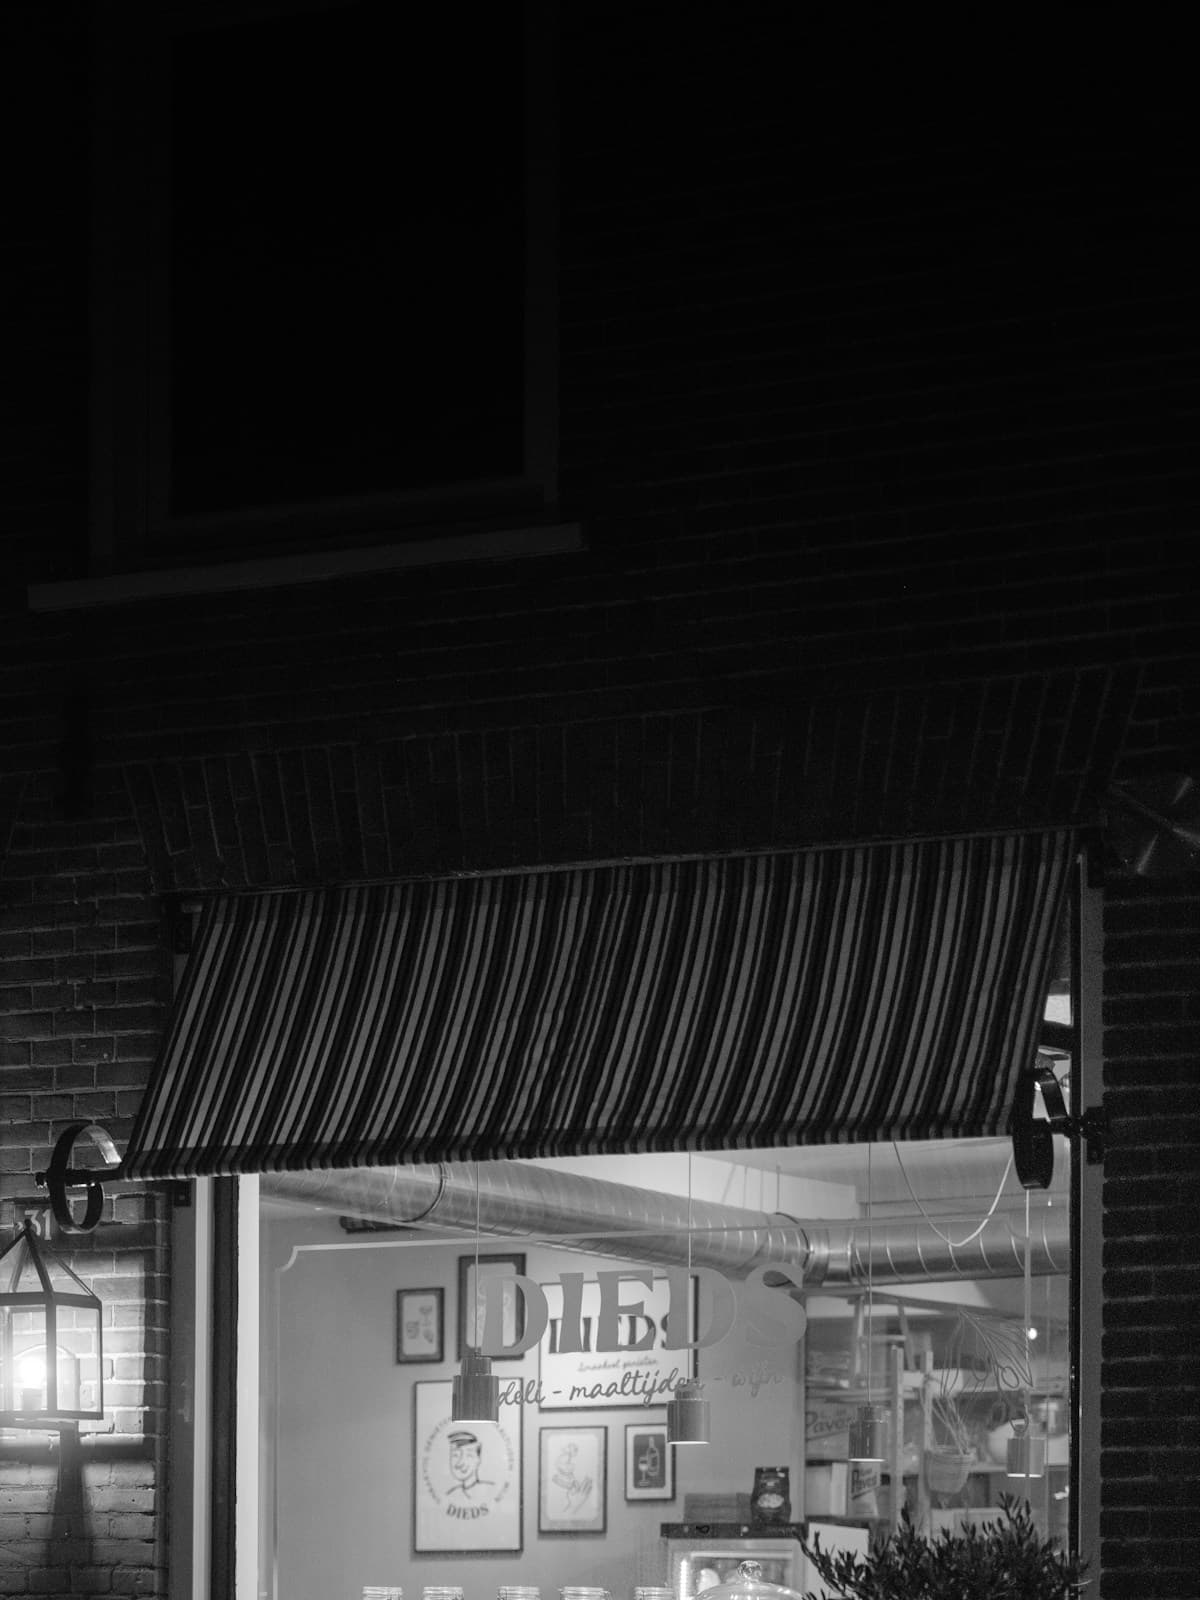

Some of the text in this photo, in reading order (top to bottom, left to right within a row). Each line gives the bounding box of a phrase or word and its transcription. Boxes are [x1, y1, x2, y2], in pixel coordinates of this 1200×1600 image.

[477, 1262, 807, 1357] DIEDS
[497, 1379, 546, 1406] deli
[446, 1502, 489, 1520] DIEDS
